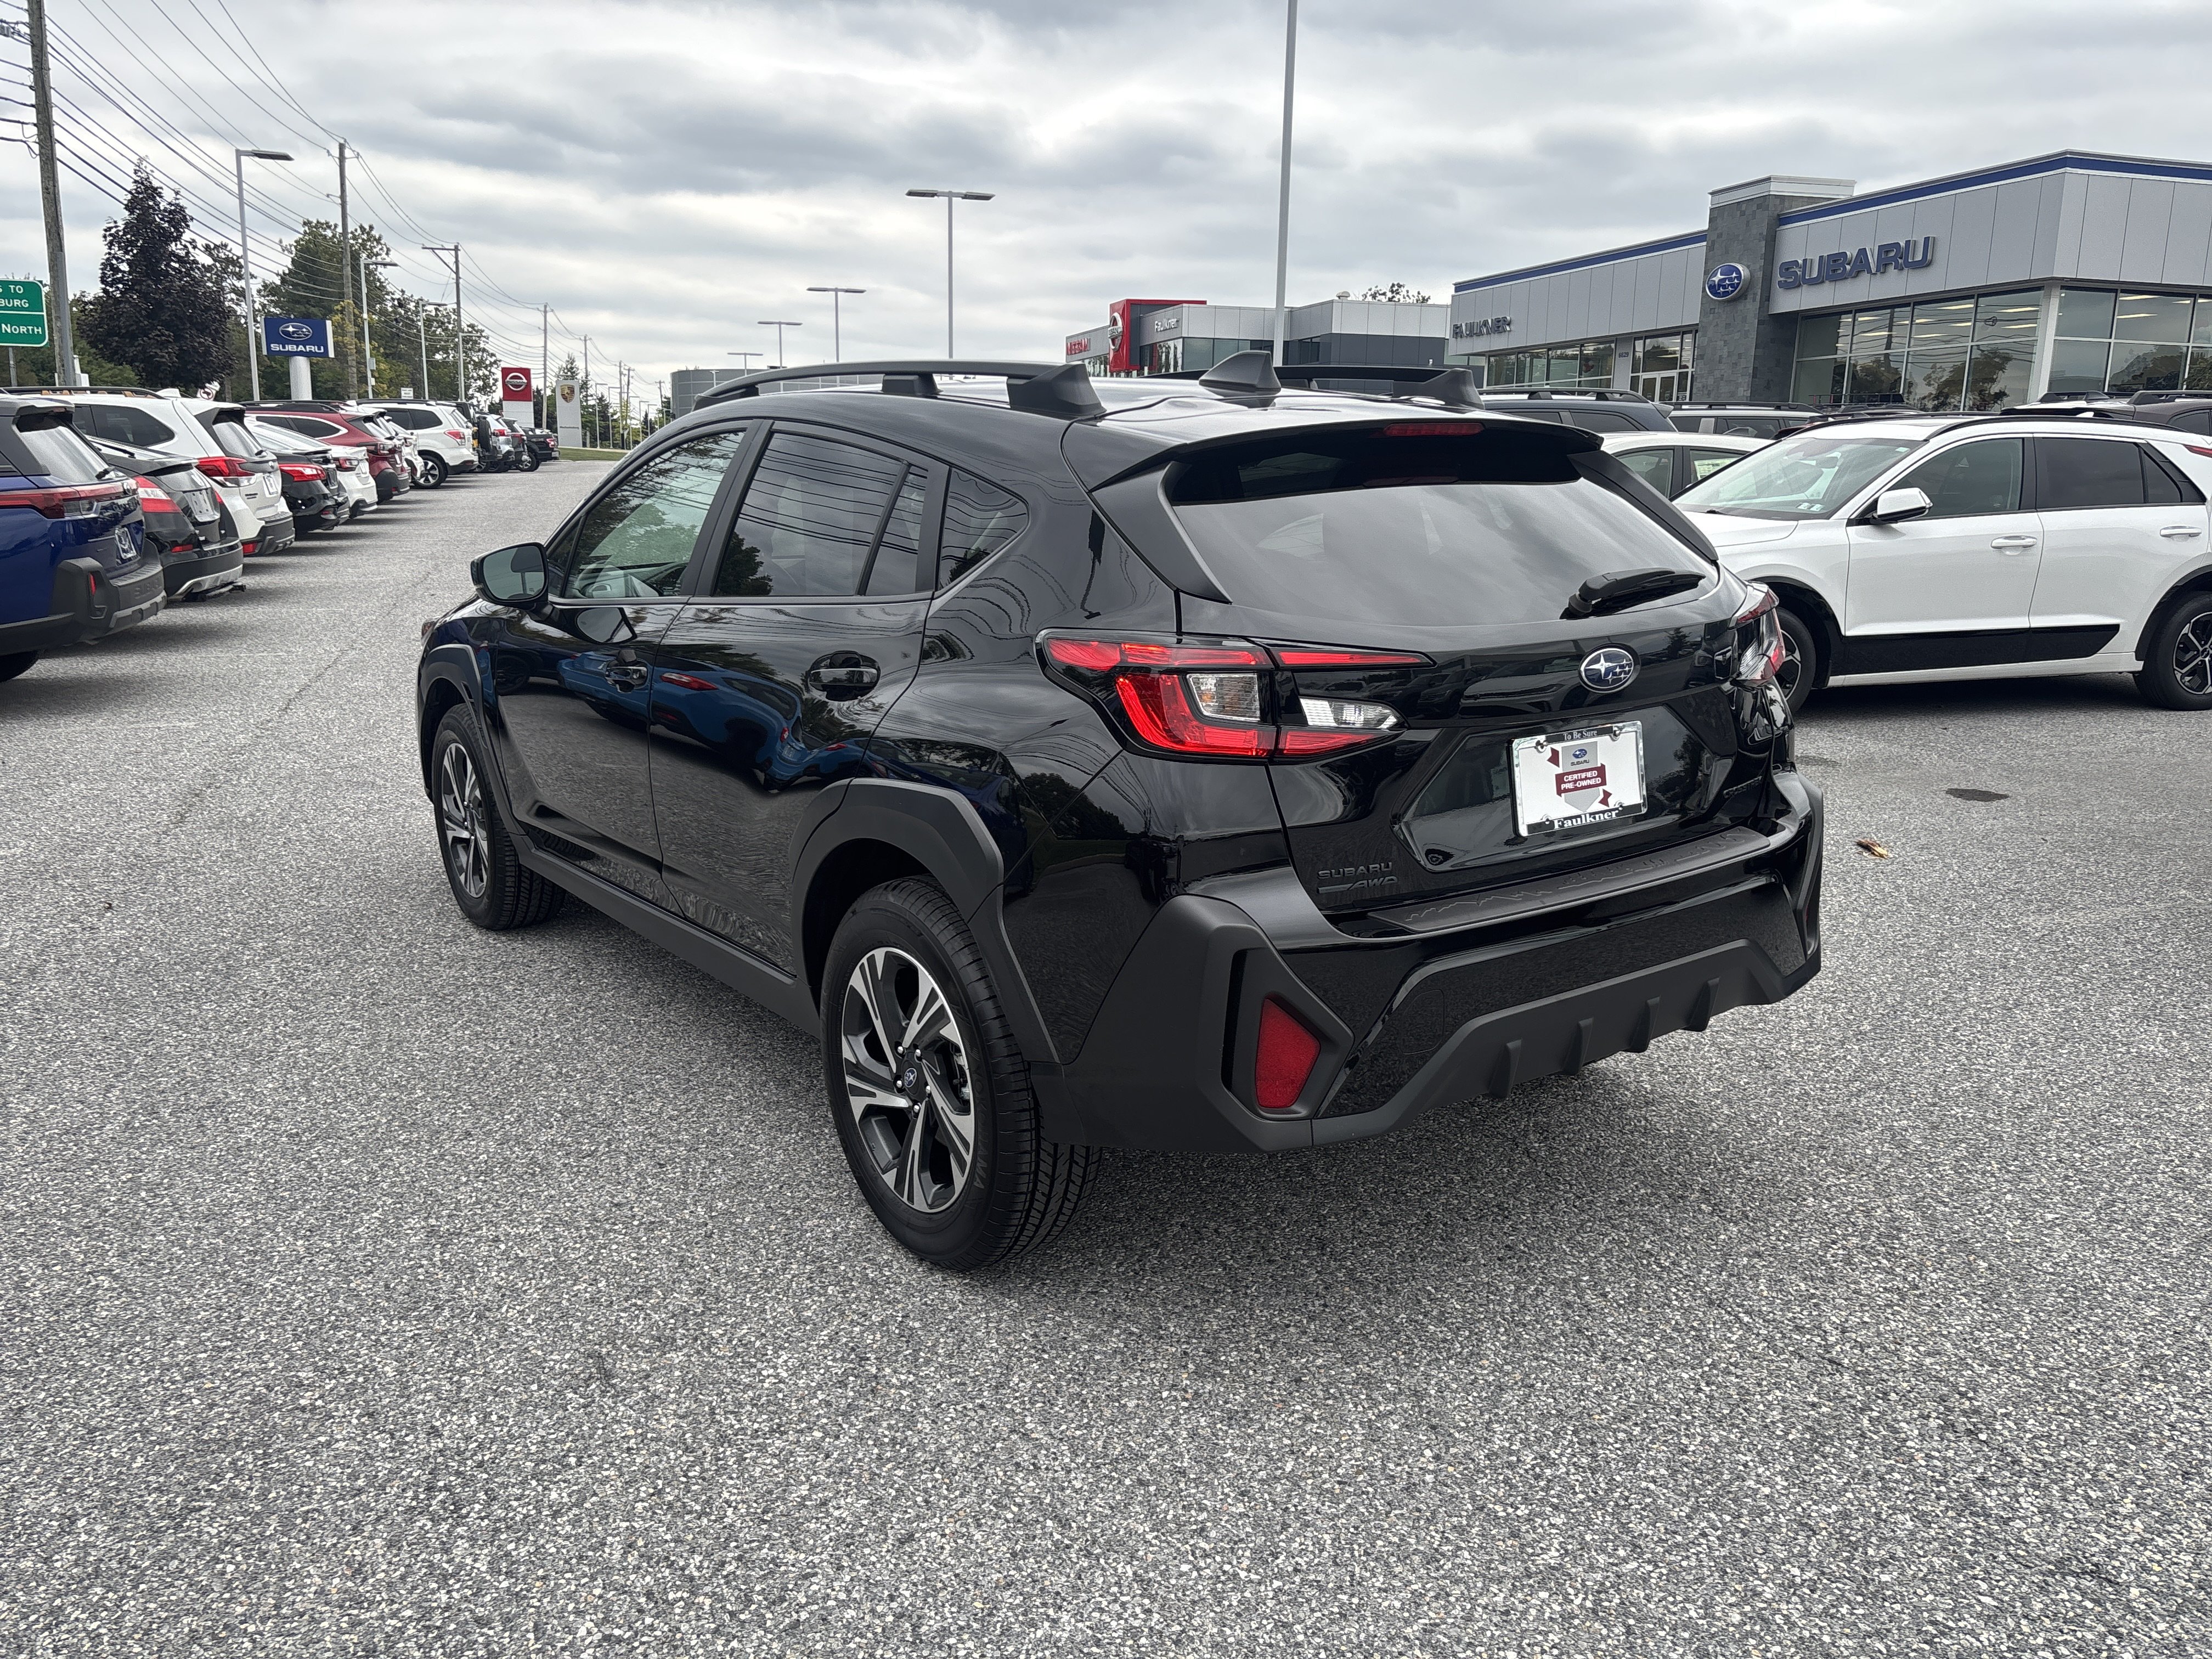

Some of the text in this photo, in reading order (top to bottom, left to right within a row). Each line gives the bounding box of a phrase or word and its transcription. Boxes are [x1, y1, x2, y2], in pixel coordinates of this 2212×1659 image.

[1778, 236, 1935, 289] SUBARU
[8, 285, 24, 294] TO
[1, 323, 42, 335] NORTH
[1154, 318, 1180, 332] Faulkner
[1452, 316, 1511, 338] FAULKNER
[270, 343, 324, 353] SUBARU
[1583, 730, 1598, 738] Sure
[1564, 770, 1598, 782] CERTIFIED
[1561, 778, 1601, 790] PRE-OWNED
[1554, 809, 1619, 829] Faulkner
[1318, 862, 1392, 879] SUBARU
[1349, 876, 1398, 890] AWD
